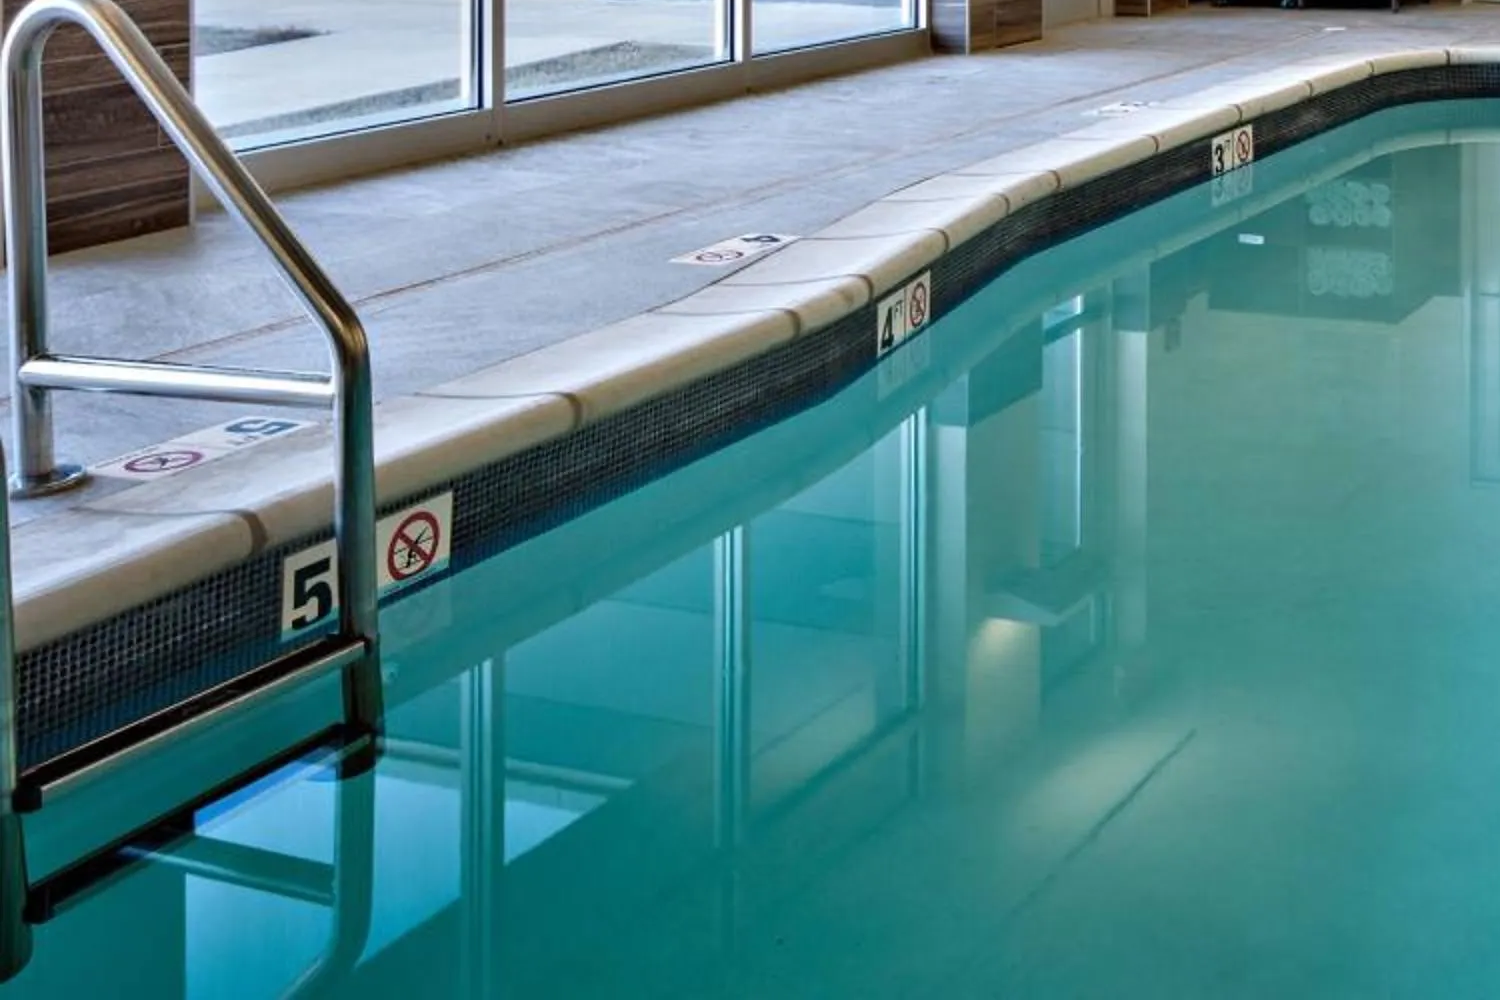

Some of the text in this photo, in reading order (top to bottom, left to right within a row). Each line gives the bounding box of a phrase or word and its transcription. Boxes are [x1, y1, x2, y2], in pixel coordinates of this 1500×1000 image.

[1215, 143, 1225, 173] 3
[881, 306, 895, 349] 4
[291, 556, 333, 631] 5
